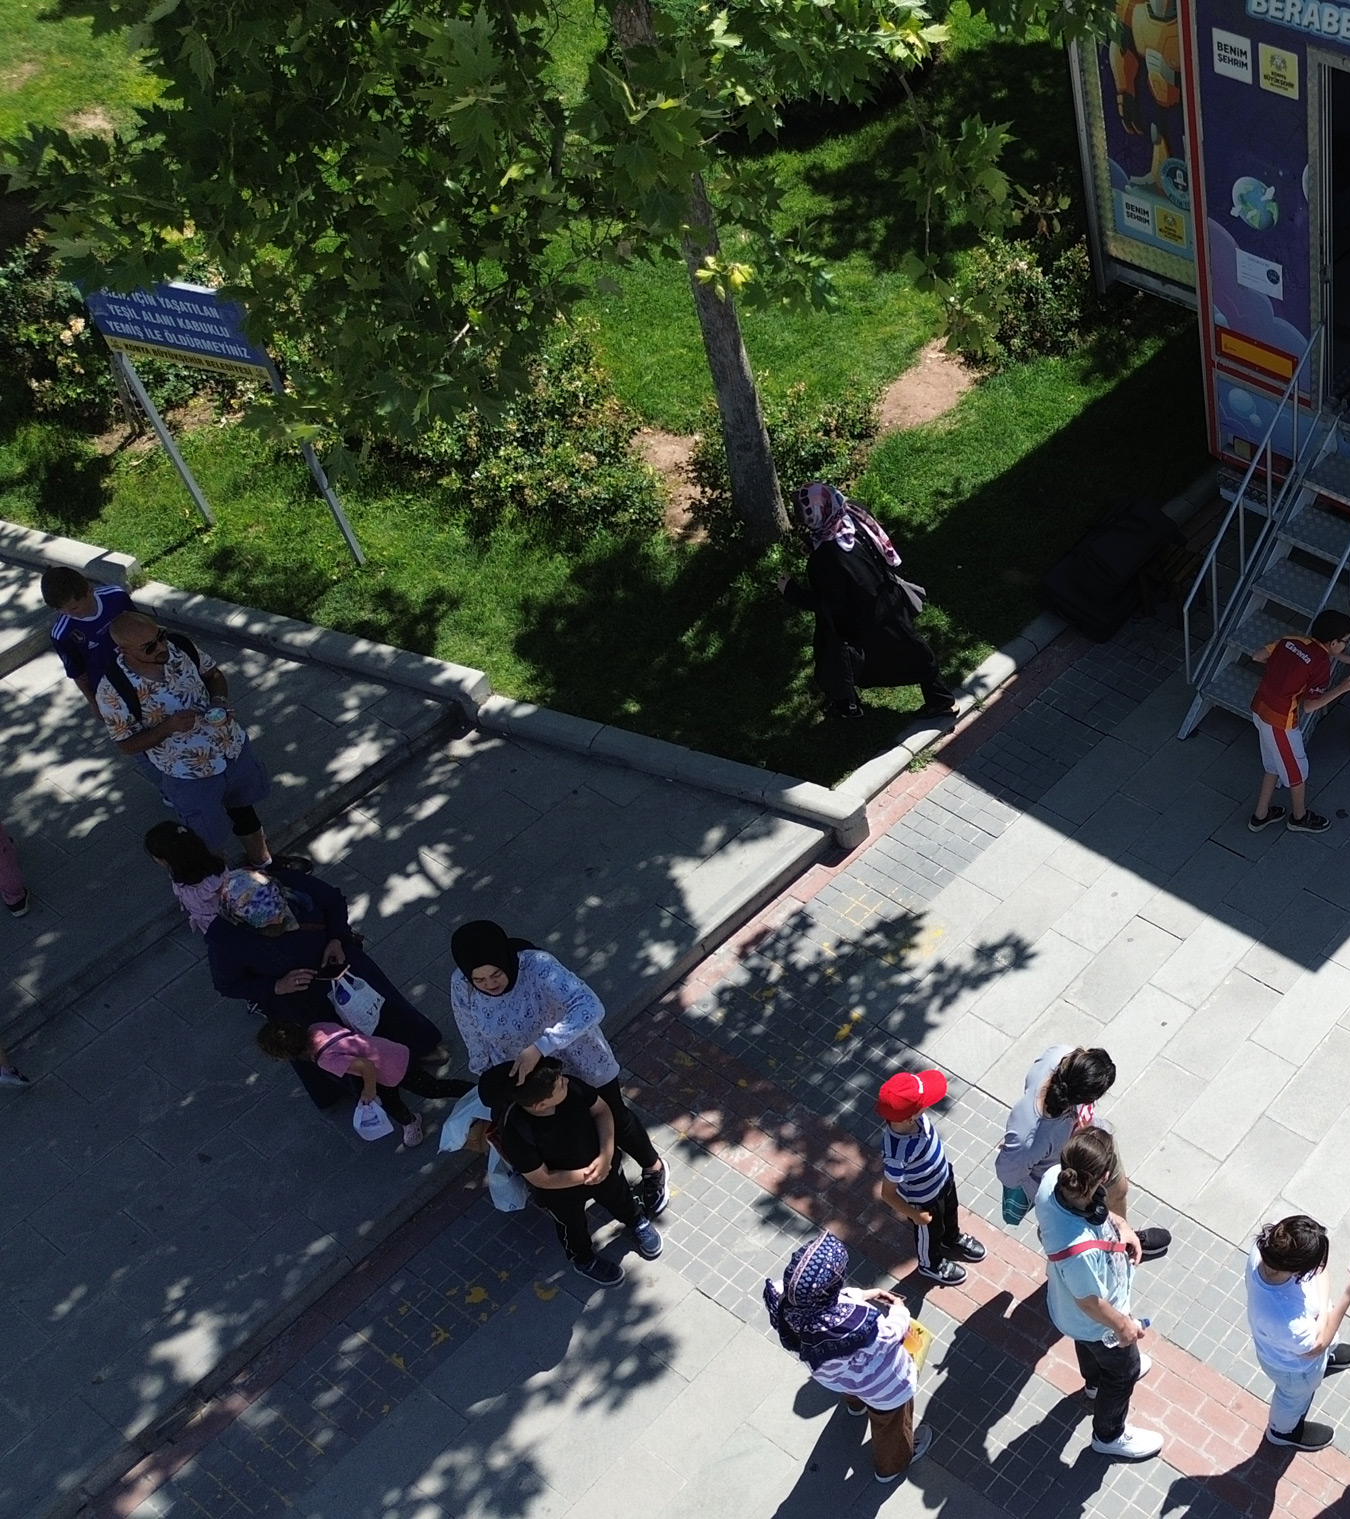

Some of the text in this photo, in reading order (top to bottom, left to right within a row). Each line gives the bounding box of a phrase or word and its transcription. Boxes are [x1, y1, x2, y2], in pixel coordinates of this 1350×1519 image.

[1216, 41, 1248, 60] BENİM
[1217, 53, 1249, 71] ŞEHRİM
[1125, 202, 1150, 218] BENİM
[156, 296, 221, 320] YAŞATILAN
[106, 303, 231, 338] YEŞİL ALANI KABUKLU
[104, 320, 251, 359] YEMİŞ İLE ÖLDÜRMEYİNİZ
[122, 342, 253, 376] KONYA BÜYÜKŞEHİR BELEDİYESİ
